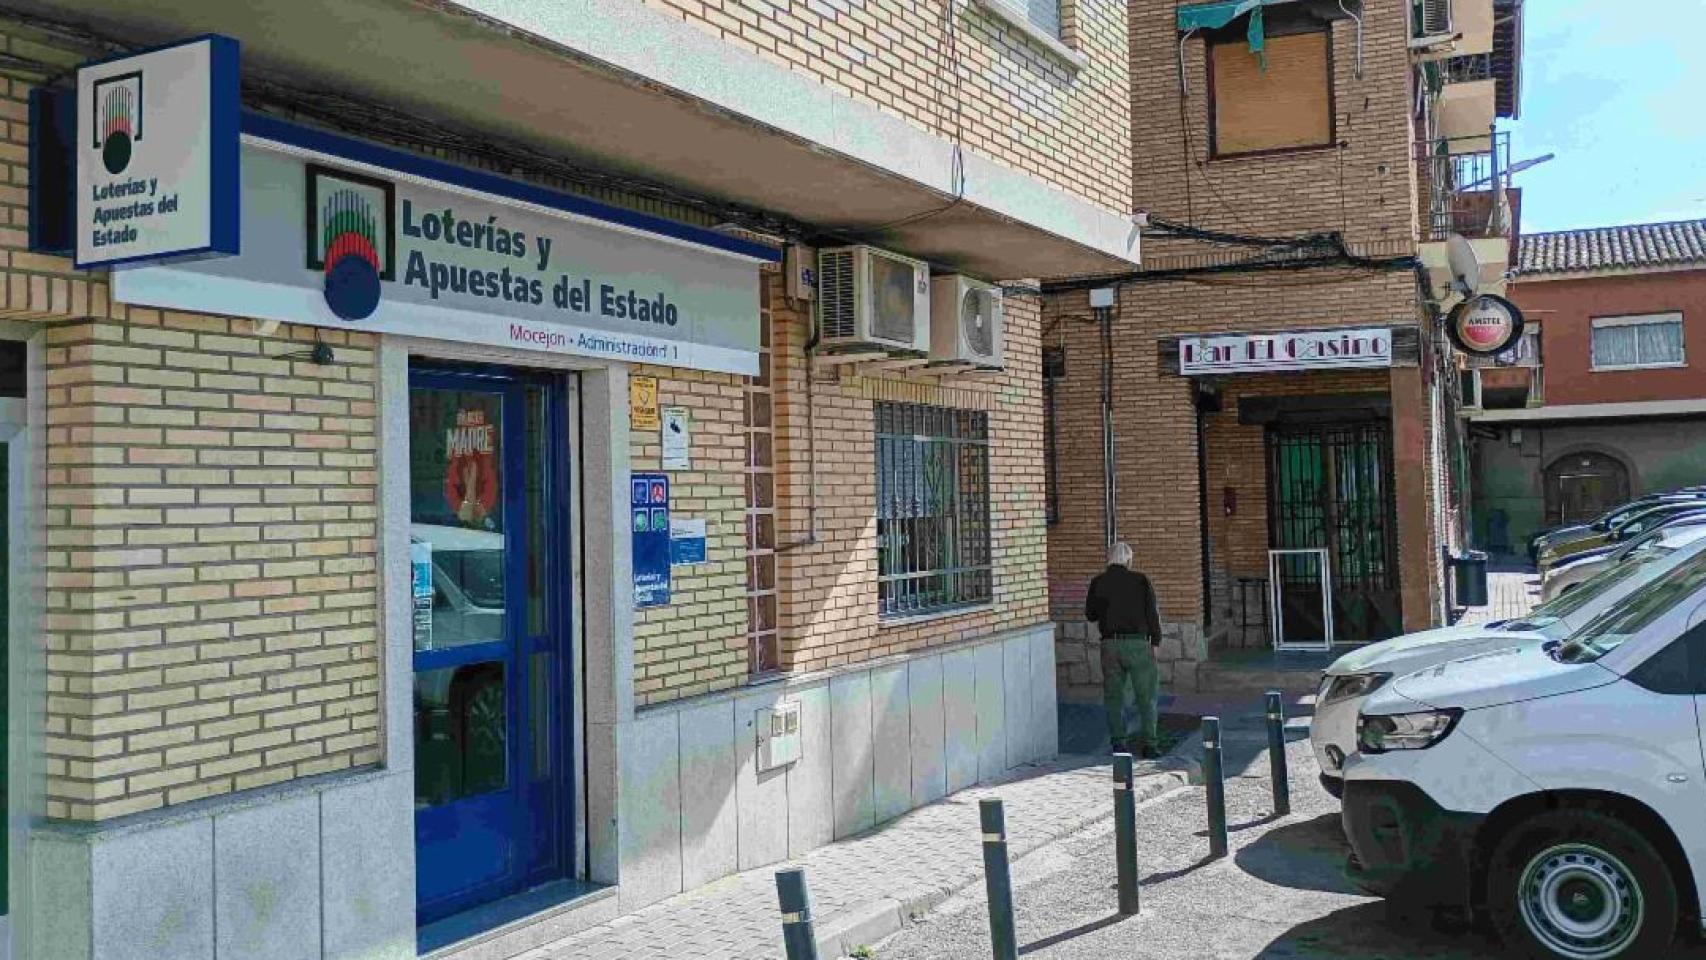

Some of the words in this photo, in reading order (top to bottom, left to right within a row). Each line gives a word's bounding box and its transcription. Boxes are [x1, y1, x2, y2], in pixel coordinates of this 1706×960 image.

[93, 177, 146, 201] Loterías
[150, 177, 157, 196] y
[93, 201, 154, 227] Apuestas
[158, 193, 178, 214] del
[93, 224, 137, 247] Estado
[402, 199, 526, 258] Loterías
[536, 236, 552, 271] y
[404, 249, 543, 299] Apuestas
[552, 275, 591, 312] del
[600, 284, 678, 326] Estado
[1468, 317, 1502, 325] AMSTEL
[1184, 344, 1237, 363] Bar
[1285, 335, 1389, 358] Casino
